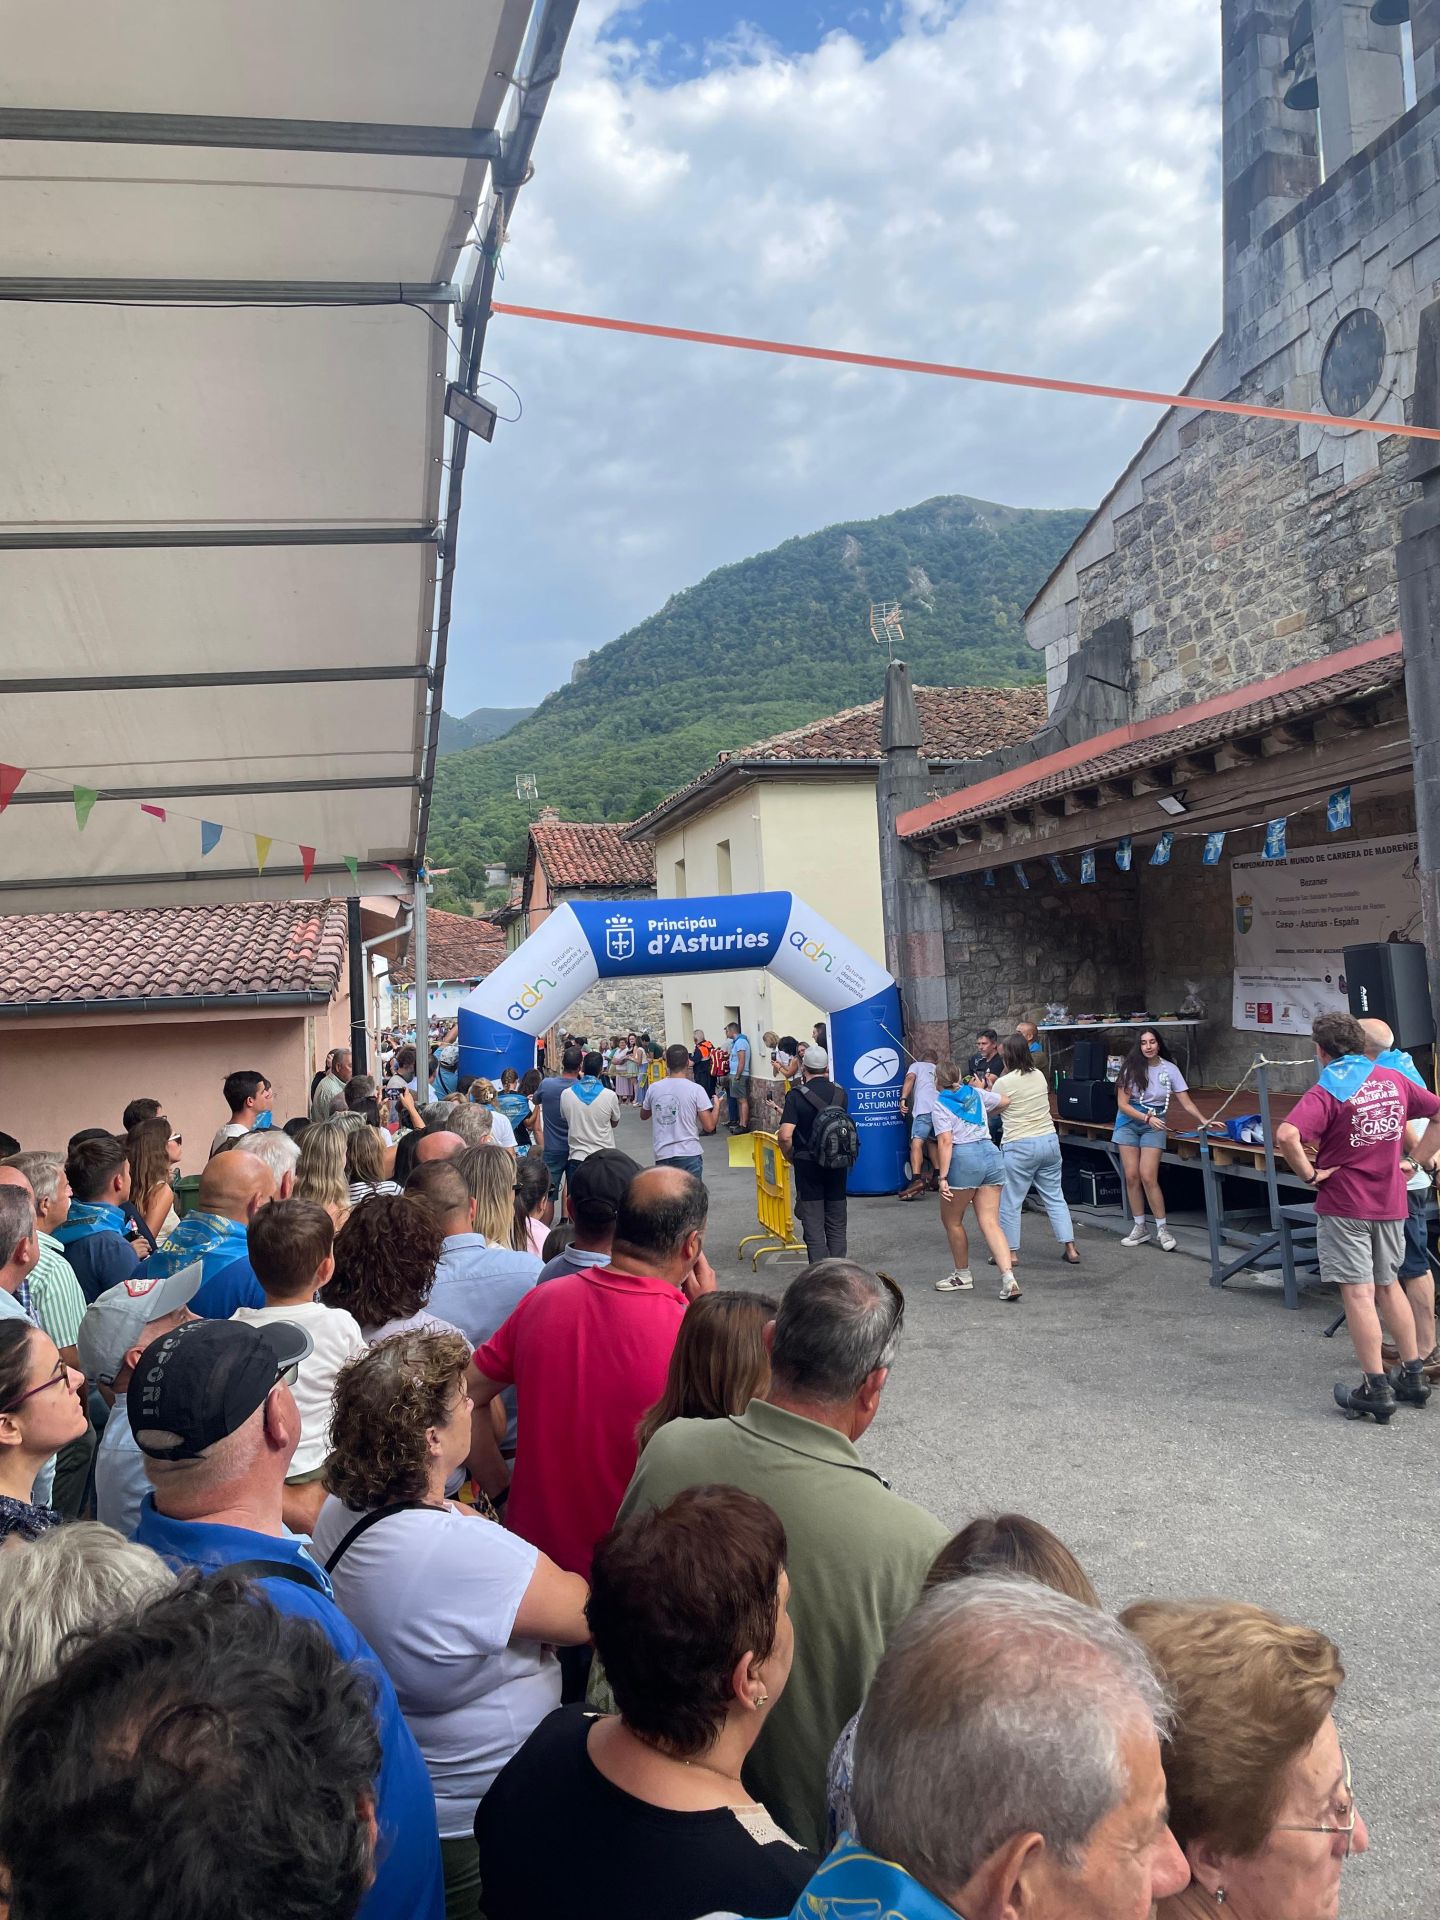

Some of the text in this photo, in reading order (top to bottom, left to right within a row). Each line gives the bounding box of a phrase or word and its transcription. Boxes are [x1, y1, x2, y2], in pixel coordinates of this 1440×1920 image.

[1275, 859, 1288, 867] DEL
[1290, 855, 1315, 865] MUNDO
[1316, 854, 1326, 862] DE
[1327, 850, 1361, 861] CARRERA
[1363, 848, 1374, 857] DE
[648, 915, 717, 933] Principáu
[1300, 918, 1328, 928] Asturias
[648, 928, 769, 954] d’Asturies
[790, 931, 832, 973] adn
[507, 979, 557, 1021] adn
[857, 1089, 901, 1100] DEPORTE
[1363, 1117, 1398, 1135] CASO
